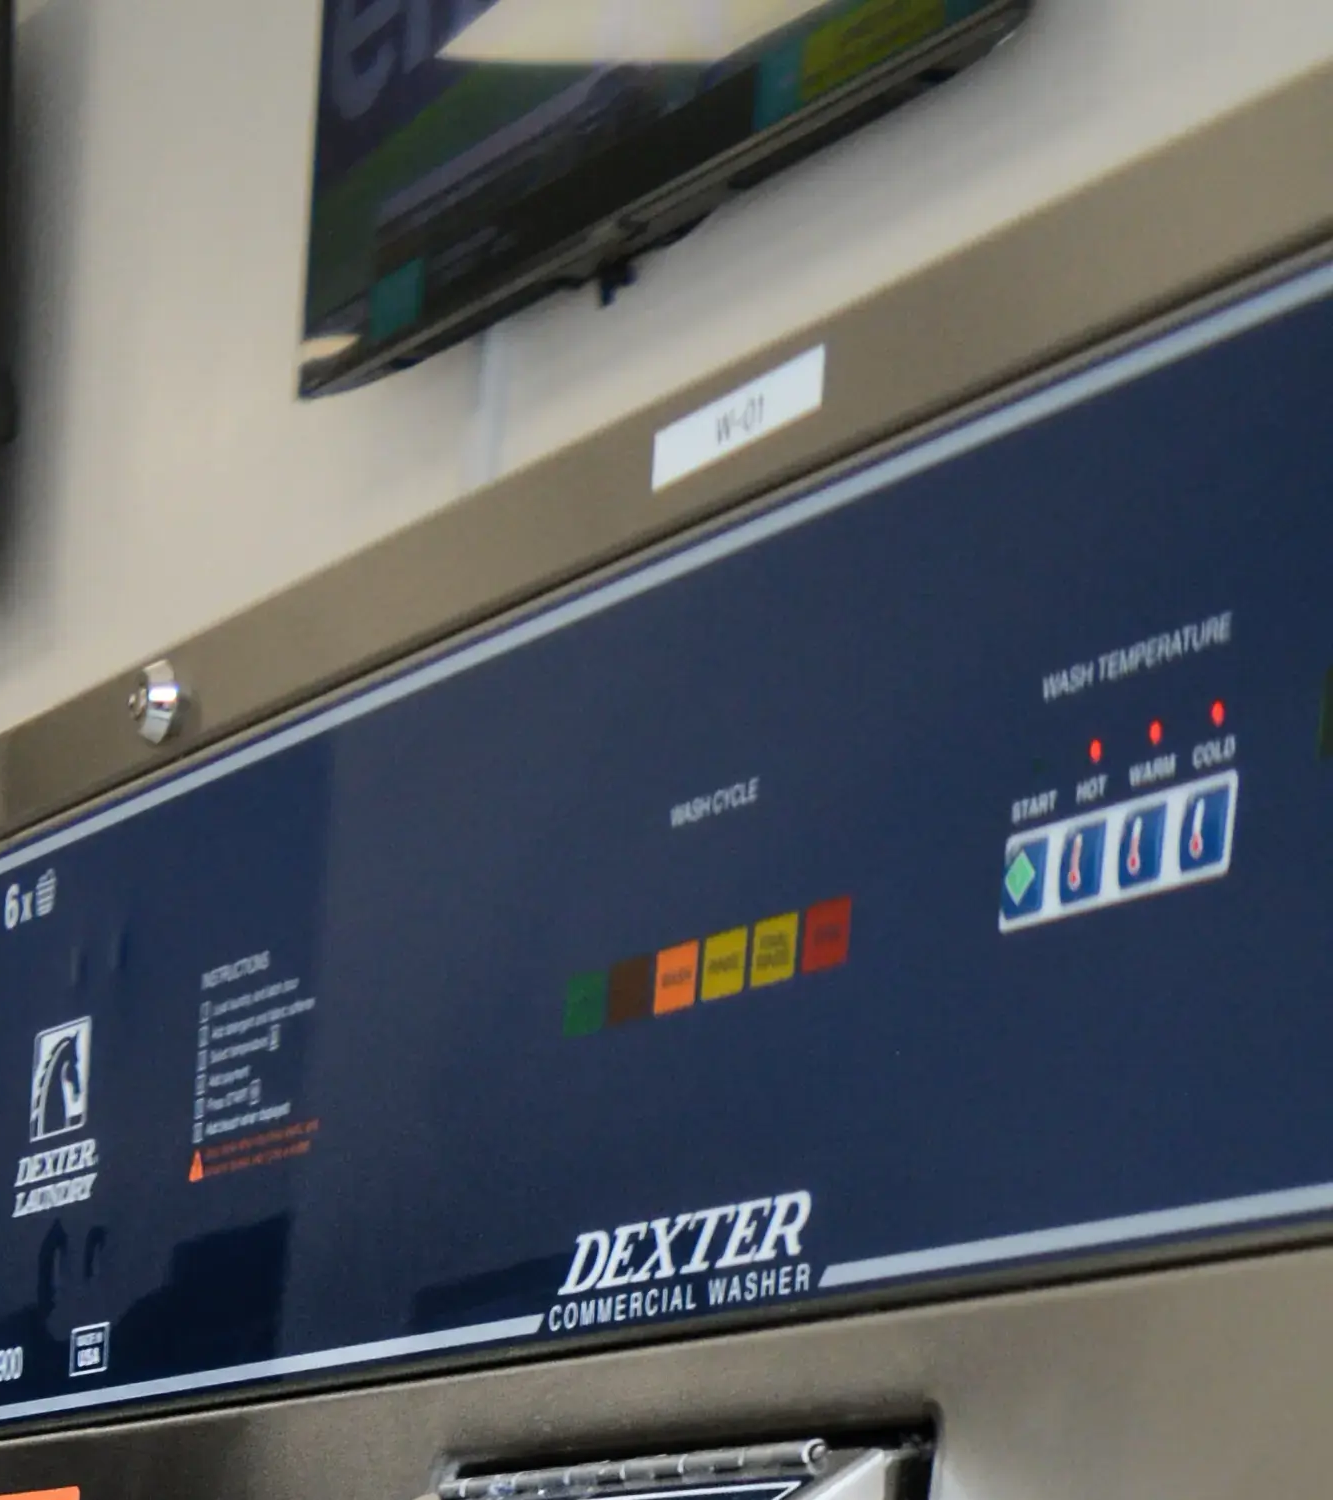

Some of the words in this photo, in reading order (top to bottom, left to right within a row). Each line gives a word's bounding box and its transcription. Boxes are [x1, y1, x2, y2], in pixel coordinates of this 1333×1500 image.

[1042, 661, 1094, 702] WASH
[1098, 611, 1233, 682] TEMPERATURE
[670, 796, 711, 828] WASH
[711, 776, 760, 815] CYCLE
[1012, 790, 1058, 824] START
[1075, 774, 1108, 804] HOT
[1129, 753, 1177, 787] WARM
[1192, 735, 1237, 770] COLD
[11, 1172, 98, 1218] LAUNDRY
[14, 1138, 96, 1188] DEXTER
[557, 1189, 813, 1296] DEXTER
[548, 1284, 697, 1332] COMMERCIAL
[707, 1263, 812, 1306] WASHER
